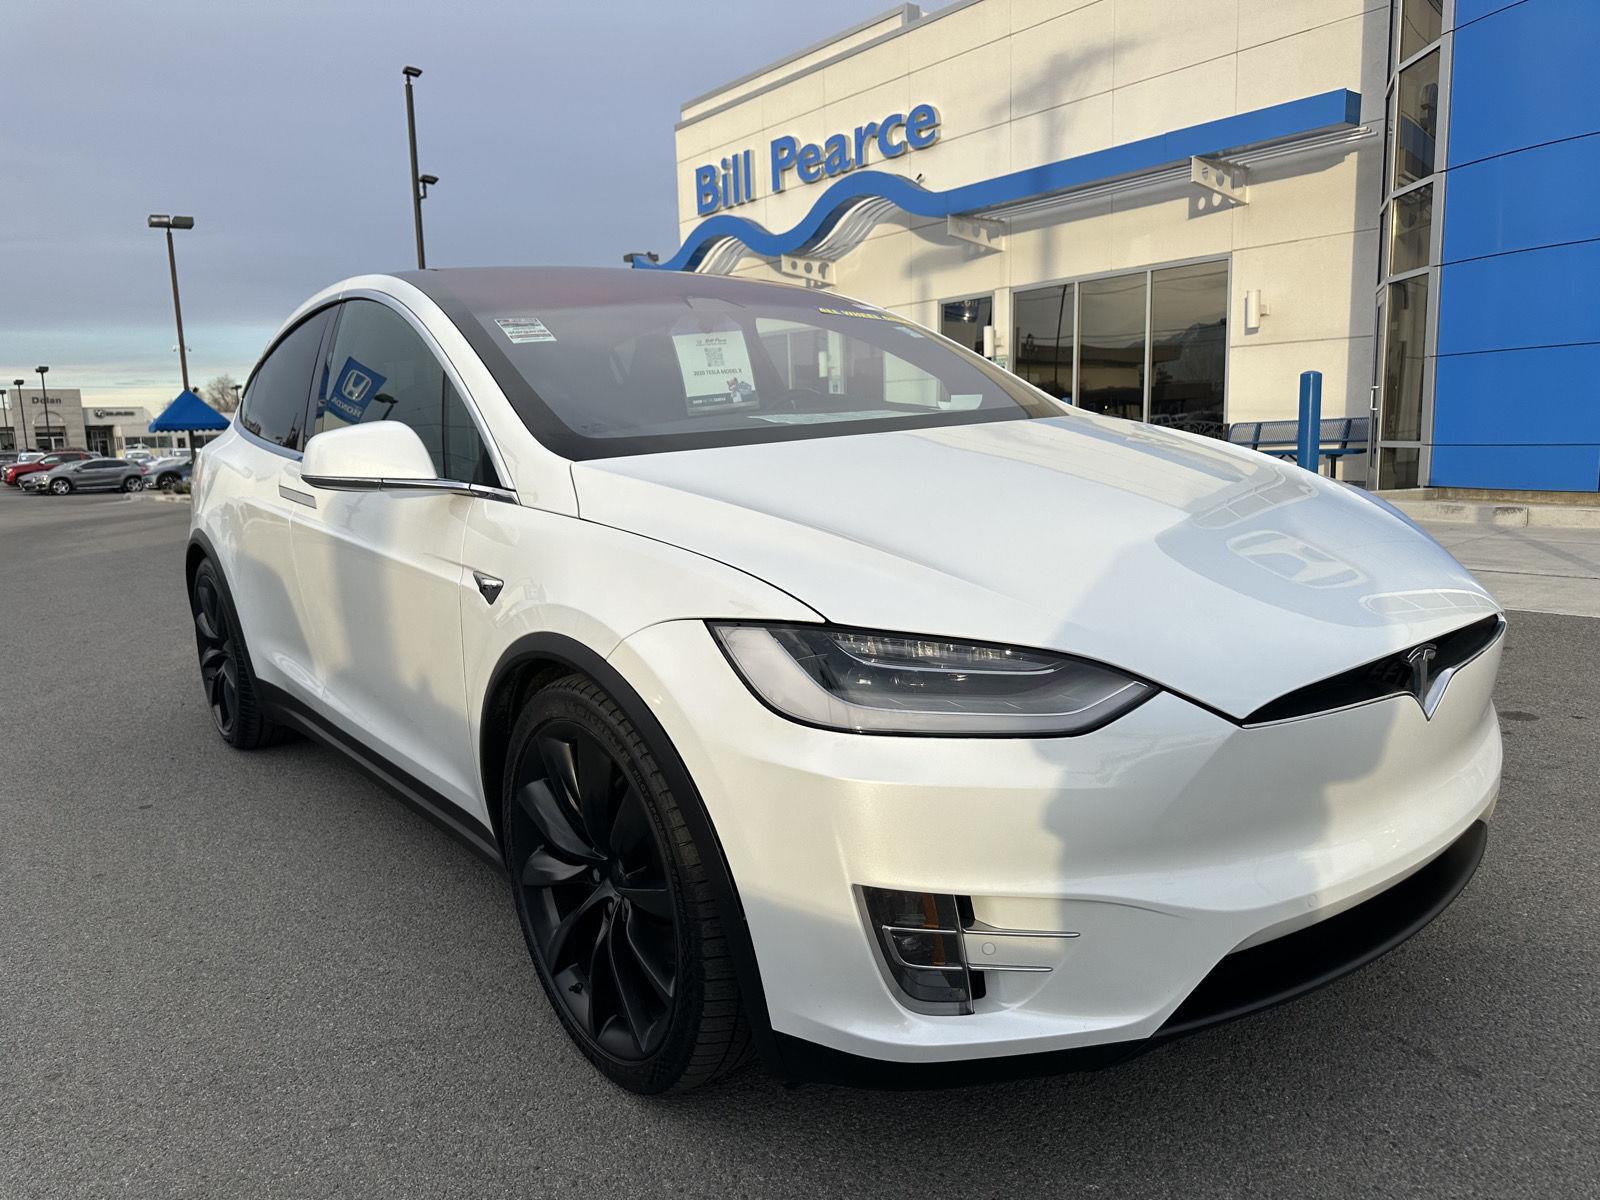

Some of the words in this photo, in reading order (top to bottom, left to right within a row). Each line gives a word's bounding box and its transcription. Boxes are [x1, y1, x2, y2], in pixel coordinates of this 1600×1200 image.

[695, 149, 755, 217] Bill
[769, 103, 942, 193] Pearce
[32, 396, 62, 405] Dolan
